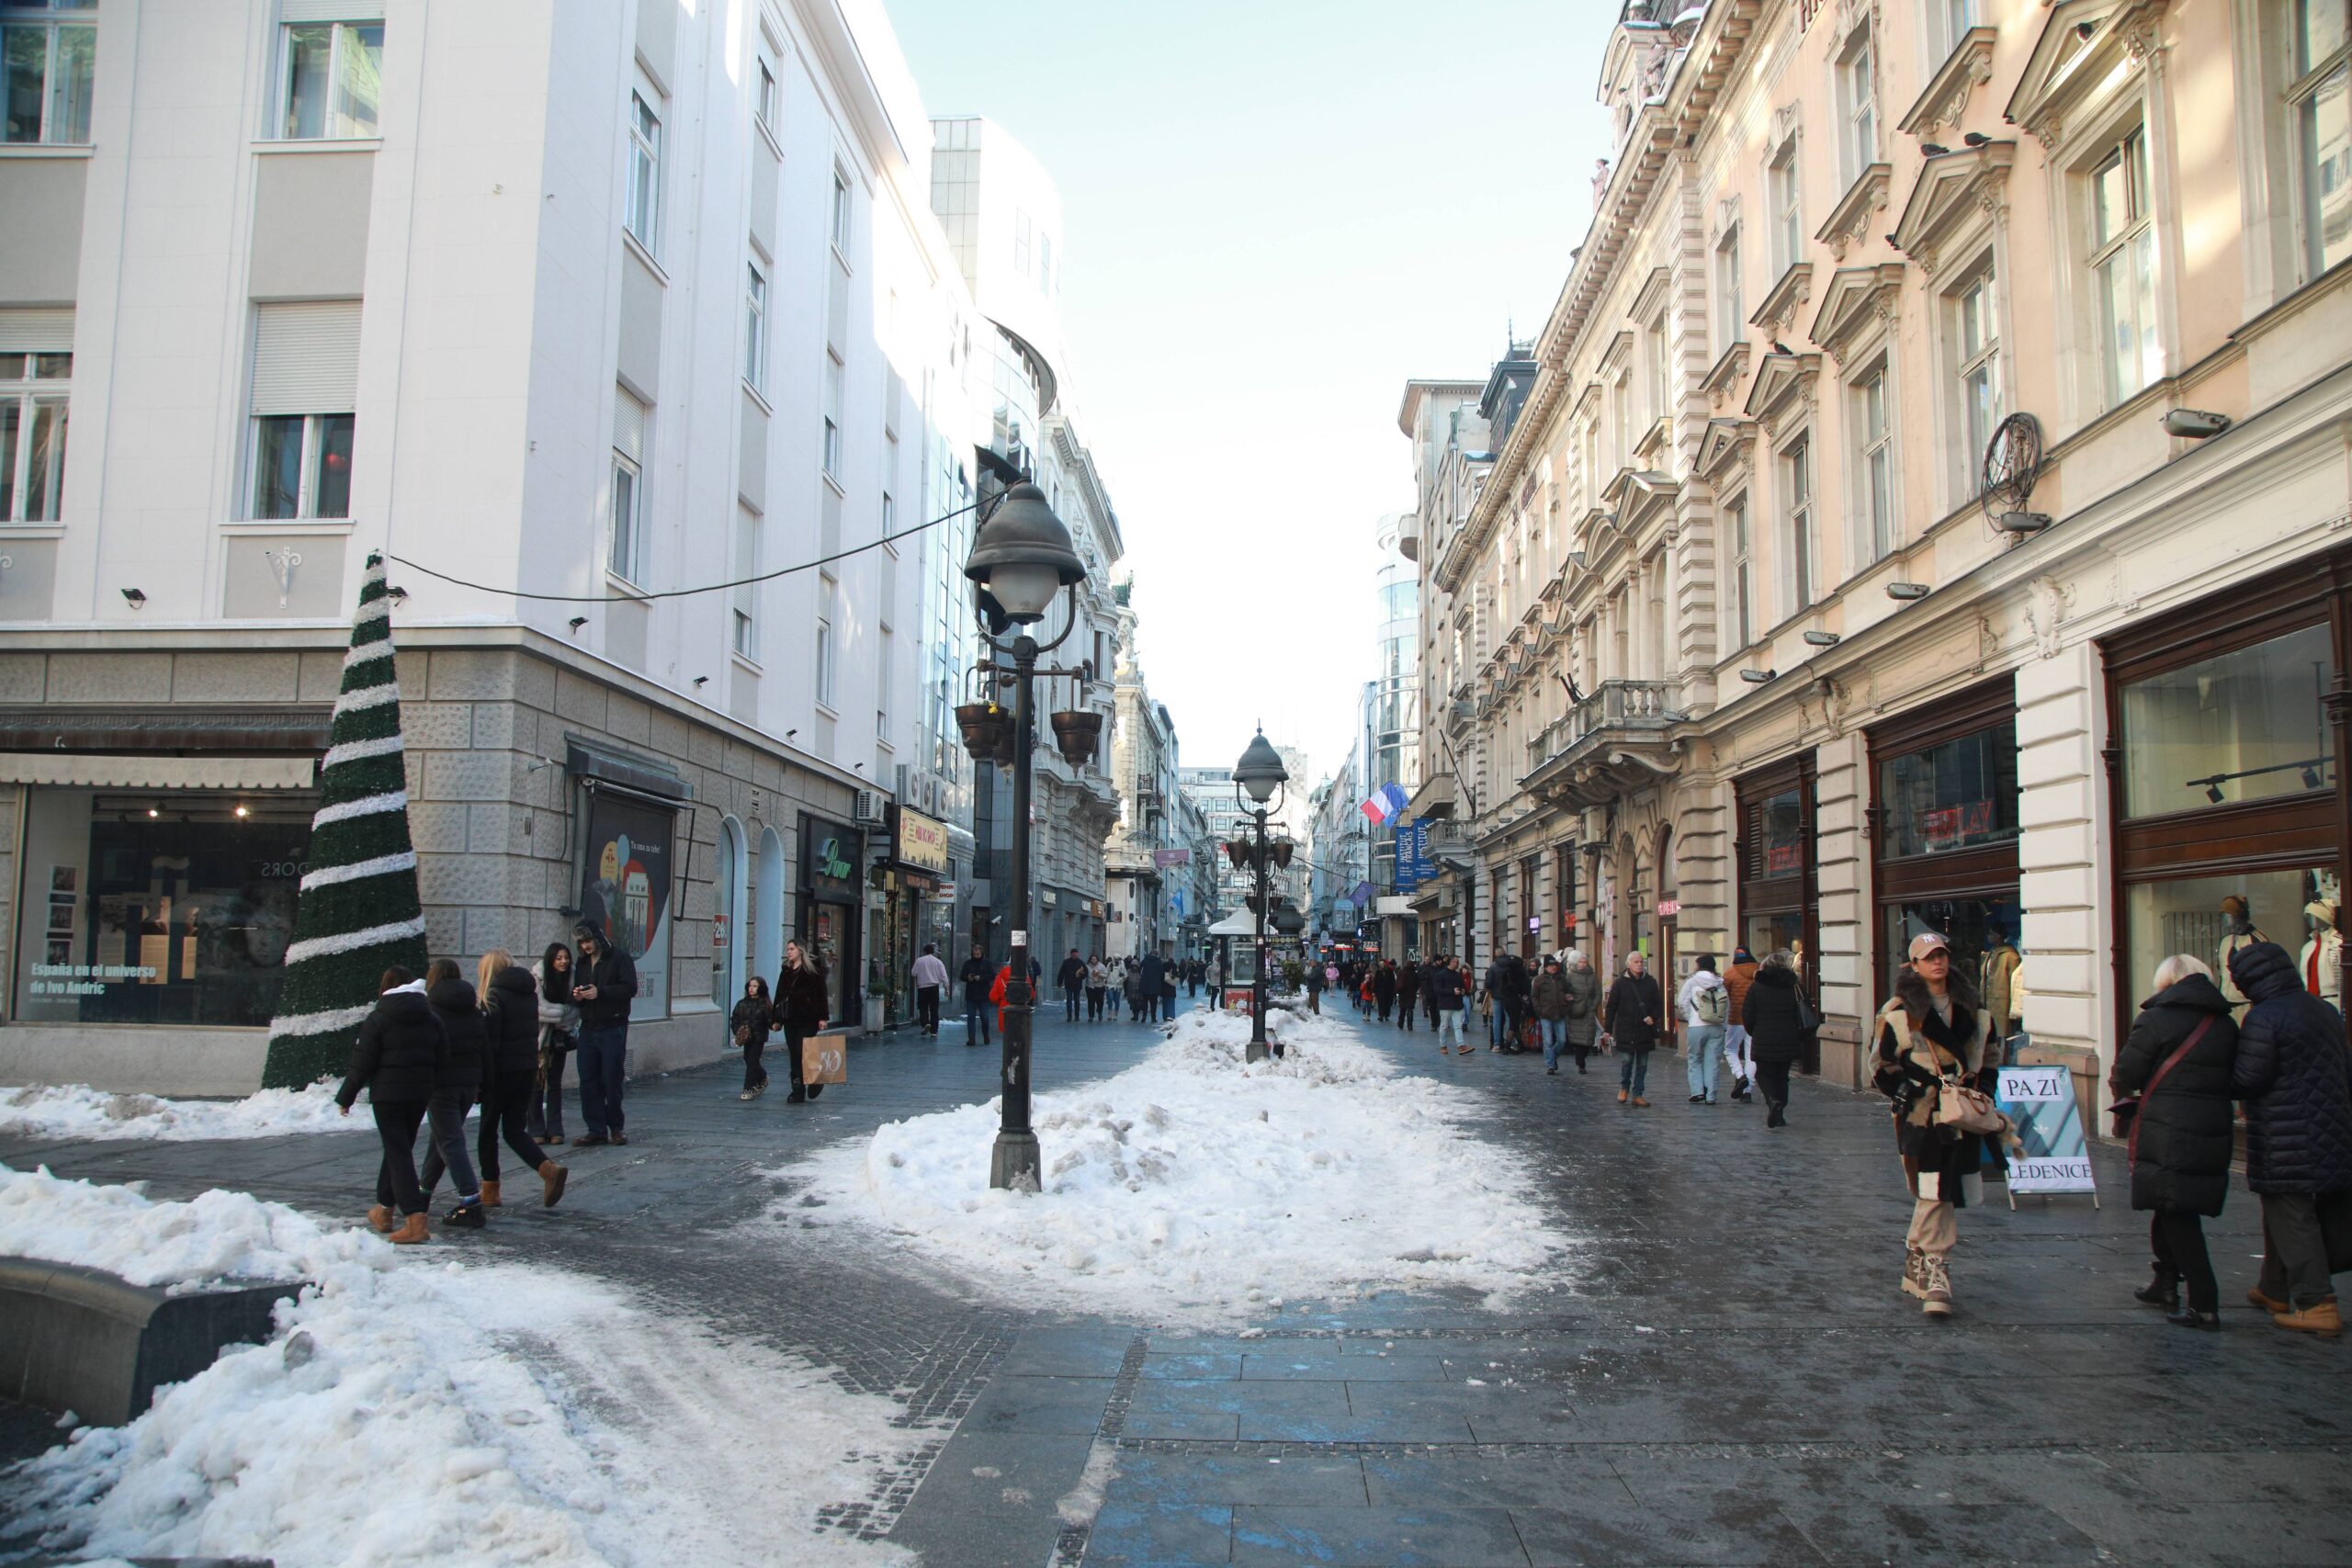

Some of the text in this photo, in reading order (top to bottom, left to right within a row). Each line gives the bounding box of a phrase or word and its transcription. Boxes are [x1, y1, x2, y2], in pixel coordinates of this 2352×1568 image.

[31, 962, 156, 977] España en el universo
[30, 980, 45, 994] de
[48, 981, 63, 994] Ivo
[2008, 1164, 2093, 1179] LEDENICE
